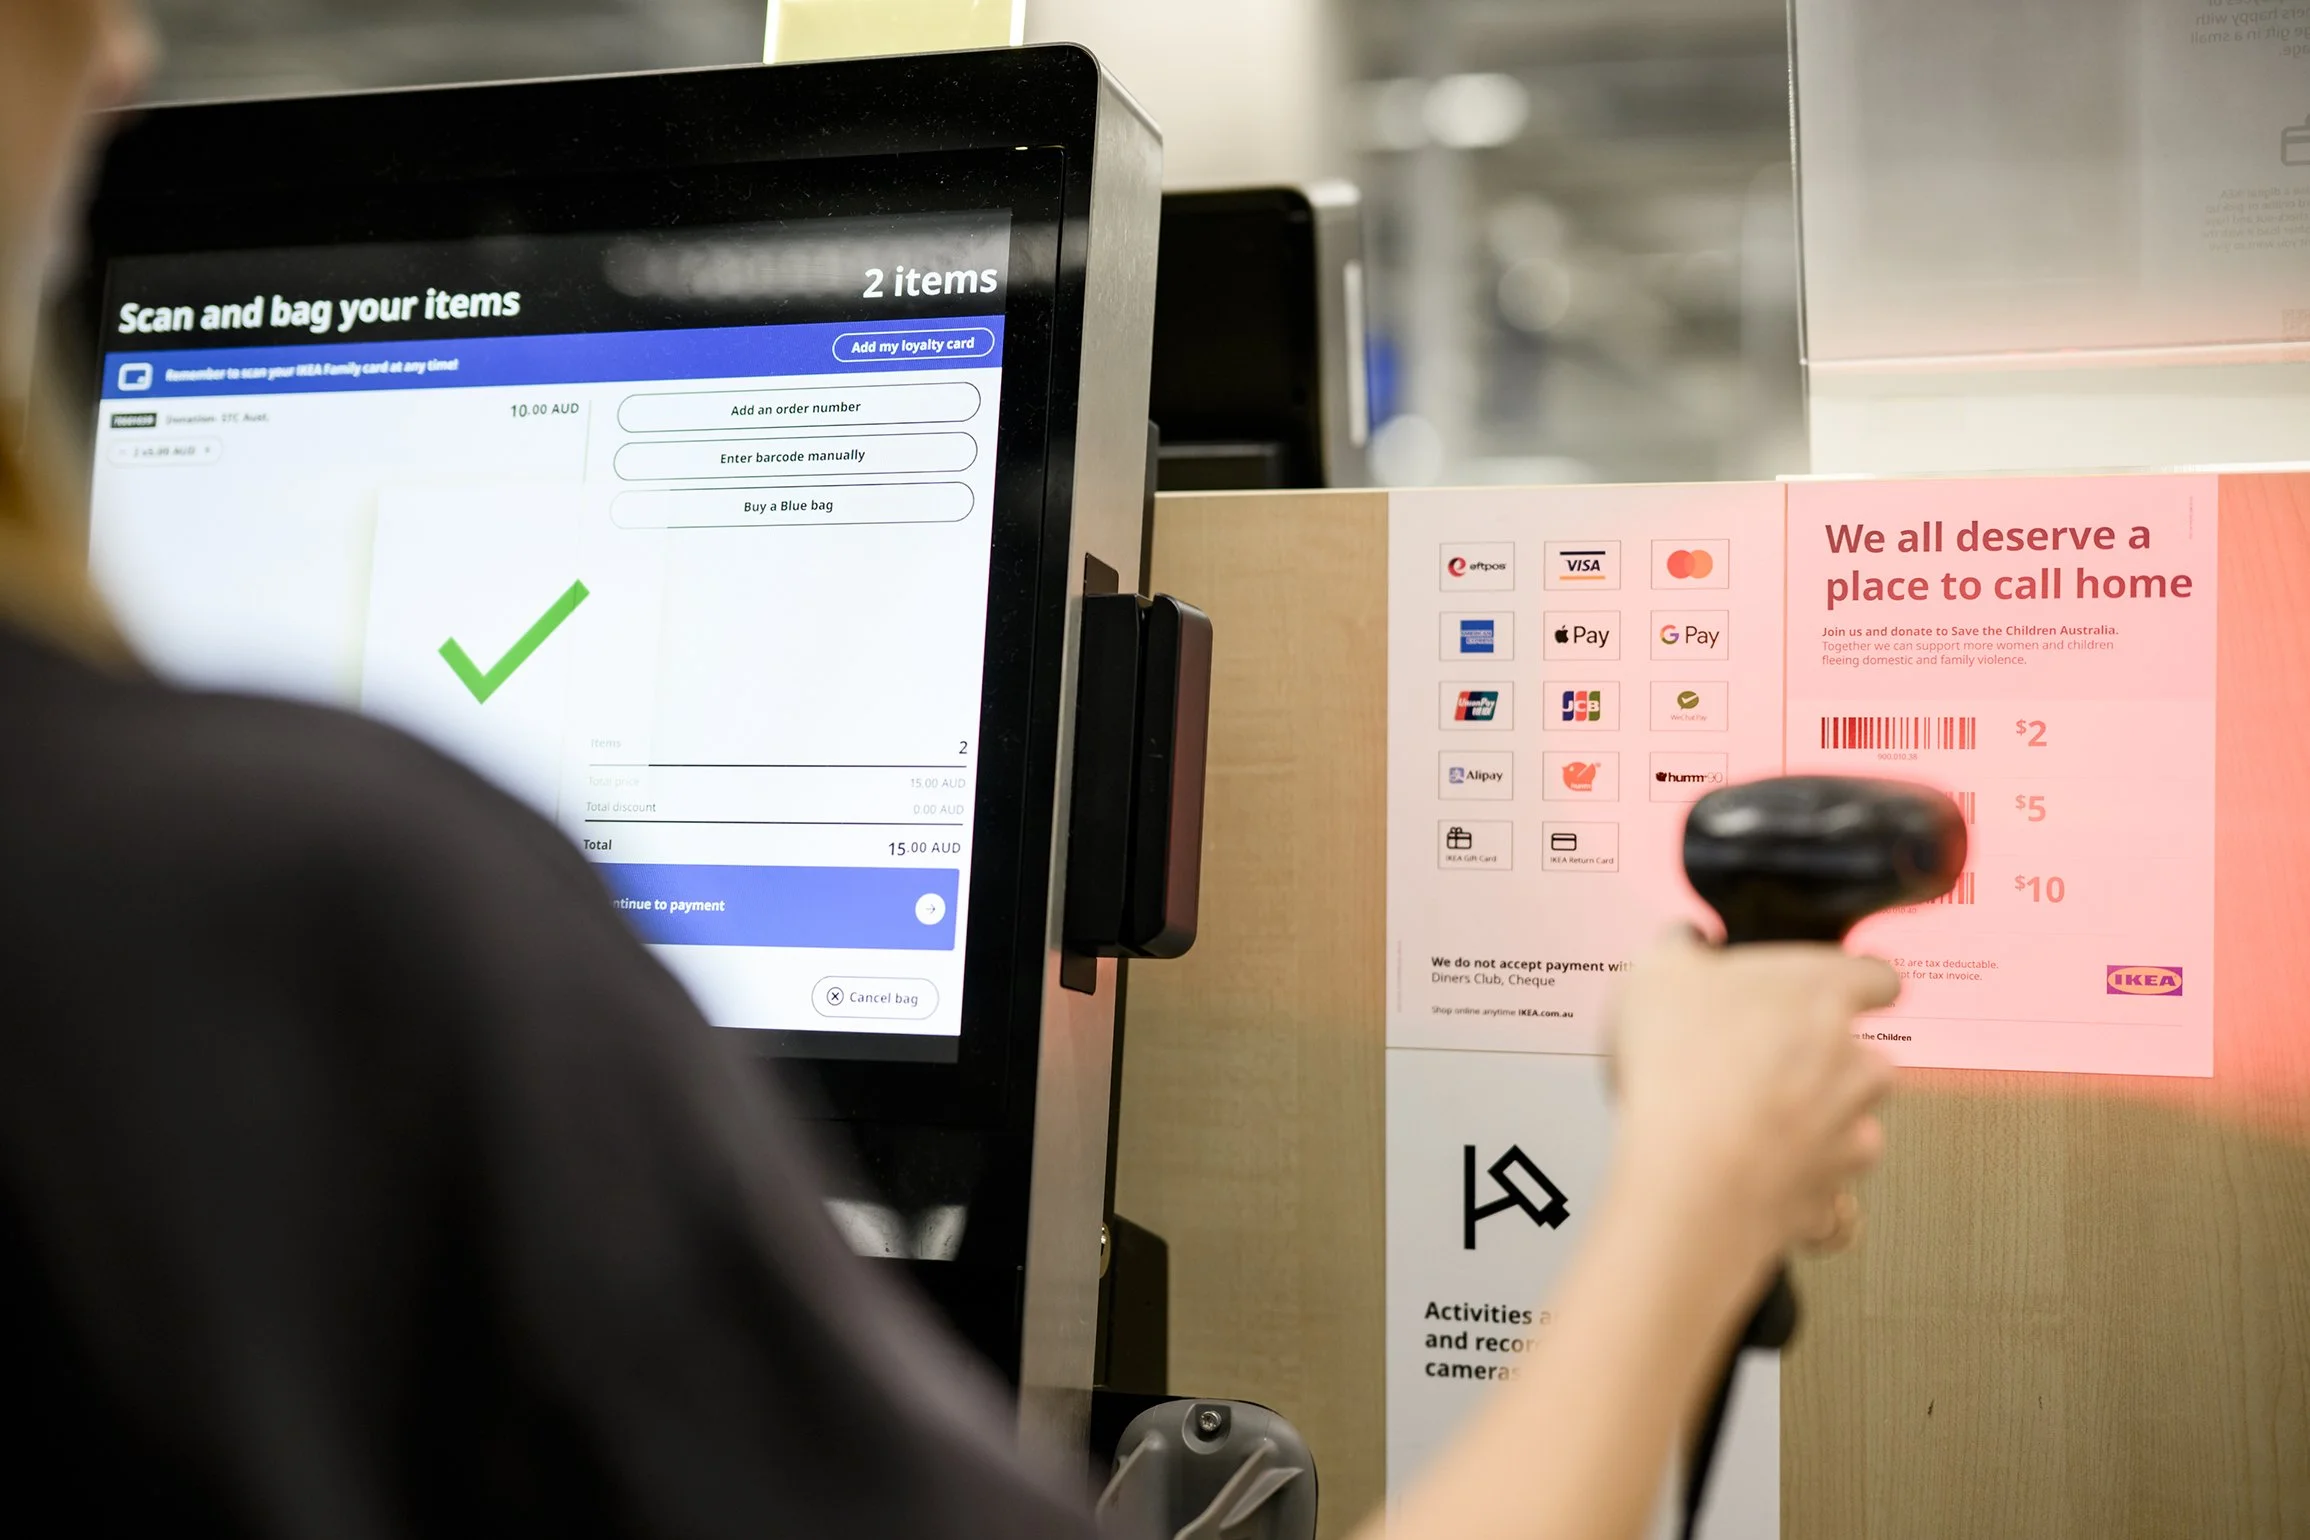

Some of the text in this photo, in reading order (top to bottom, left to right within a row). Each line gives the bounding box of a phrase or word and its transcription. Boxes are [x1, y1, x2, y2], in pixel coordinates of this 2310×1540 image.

[862, 265, 998, 298] 2 items
[118, 287, 521, 334] Scan and bag your items
[851, 337, 975, 355] Add my loyalty card
[165, 358, 459, 382] Remember to scan your IKEA Family card at any time!
[511, 403, 579, 417] 10.00 AUD
[731, 402, 861, 416] Add an order number
[720, 449, 866, 464] Enter barcode manually
[744, 500, 833, 515] Buy a Blue bag
[1825, 520, 2150, 553] We all deserve a
[1469, 561, 1506, 572] eftpos
[1566, 559, 1601, 572] VISA
[1826, 567, 2193, 611] place to call home
[1573, 625, 1610, 648] Pay
[1685, 626, 1720, 649] Pay
[1822, 625, 2119, 637] Join us and donate to Save the Children Australia.
[1822, 639, 2114, 653] Together we can support more women and children
[1822, 654, 2027, 667] fleeing domestic and family violence.
[1458, 697, 1495, 709] UnionPay
[1562, 700, 1600, 712] JCB
[2015, 719, 2048, 747] $2
[591, 738, 621, 748] Items
[958, 740, 968, 755] 2
[1466, 770, 1503, 782] Alipay
[910, 778, 966, 789] 15.00 AUD
[586, 802, 656, 813] Total discount
[913, 805, 965, 815] 0.00 AUD
[2015, 794, 2047, 822] $5
[583, 839, 612, 850] Total
[888, 842, 961, 856] 15.00 AUD
[1596, 857, 1614, 865] Card
[2014, 875, 2065, 903] $10
[611, 898, 726, 914] ntinue to payment
[1431, 957, 1451, 967] We
[1455, 957, 1470, 968] do
[1474, 959, 1496, 969] not
[1499, 960, 1542, 973] accept
[1546, 961, 1604, 973] payment
[1894, 958, 1905, 968] $2
[1907, 960, 1923, 968] are
[1925, 959, 1940, 968] tax
[1943, 960, 1999, 969] deductable.
[1431, 972, 1555, 988] Diners Club, Cheque
[1912, 971, 1926, 979] for
[1929, 971, 1943, 979] tax
[1946, 971, 1982, 980] invoice.
[2115, 973, 2176, 987] IKEA
[849, 991, 919, 1008] Cancel bag
[1431, 1006, 1574, 1018] Shop online anytime IKEA.com.au
[1862, 1032, 1875, 1040] the
[1877, 1032, 1912, 1042] Children
[1424, 1301, 1533, 1325] Activities
[1425, 1331, 1468, 1350] and
